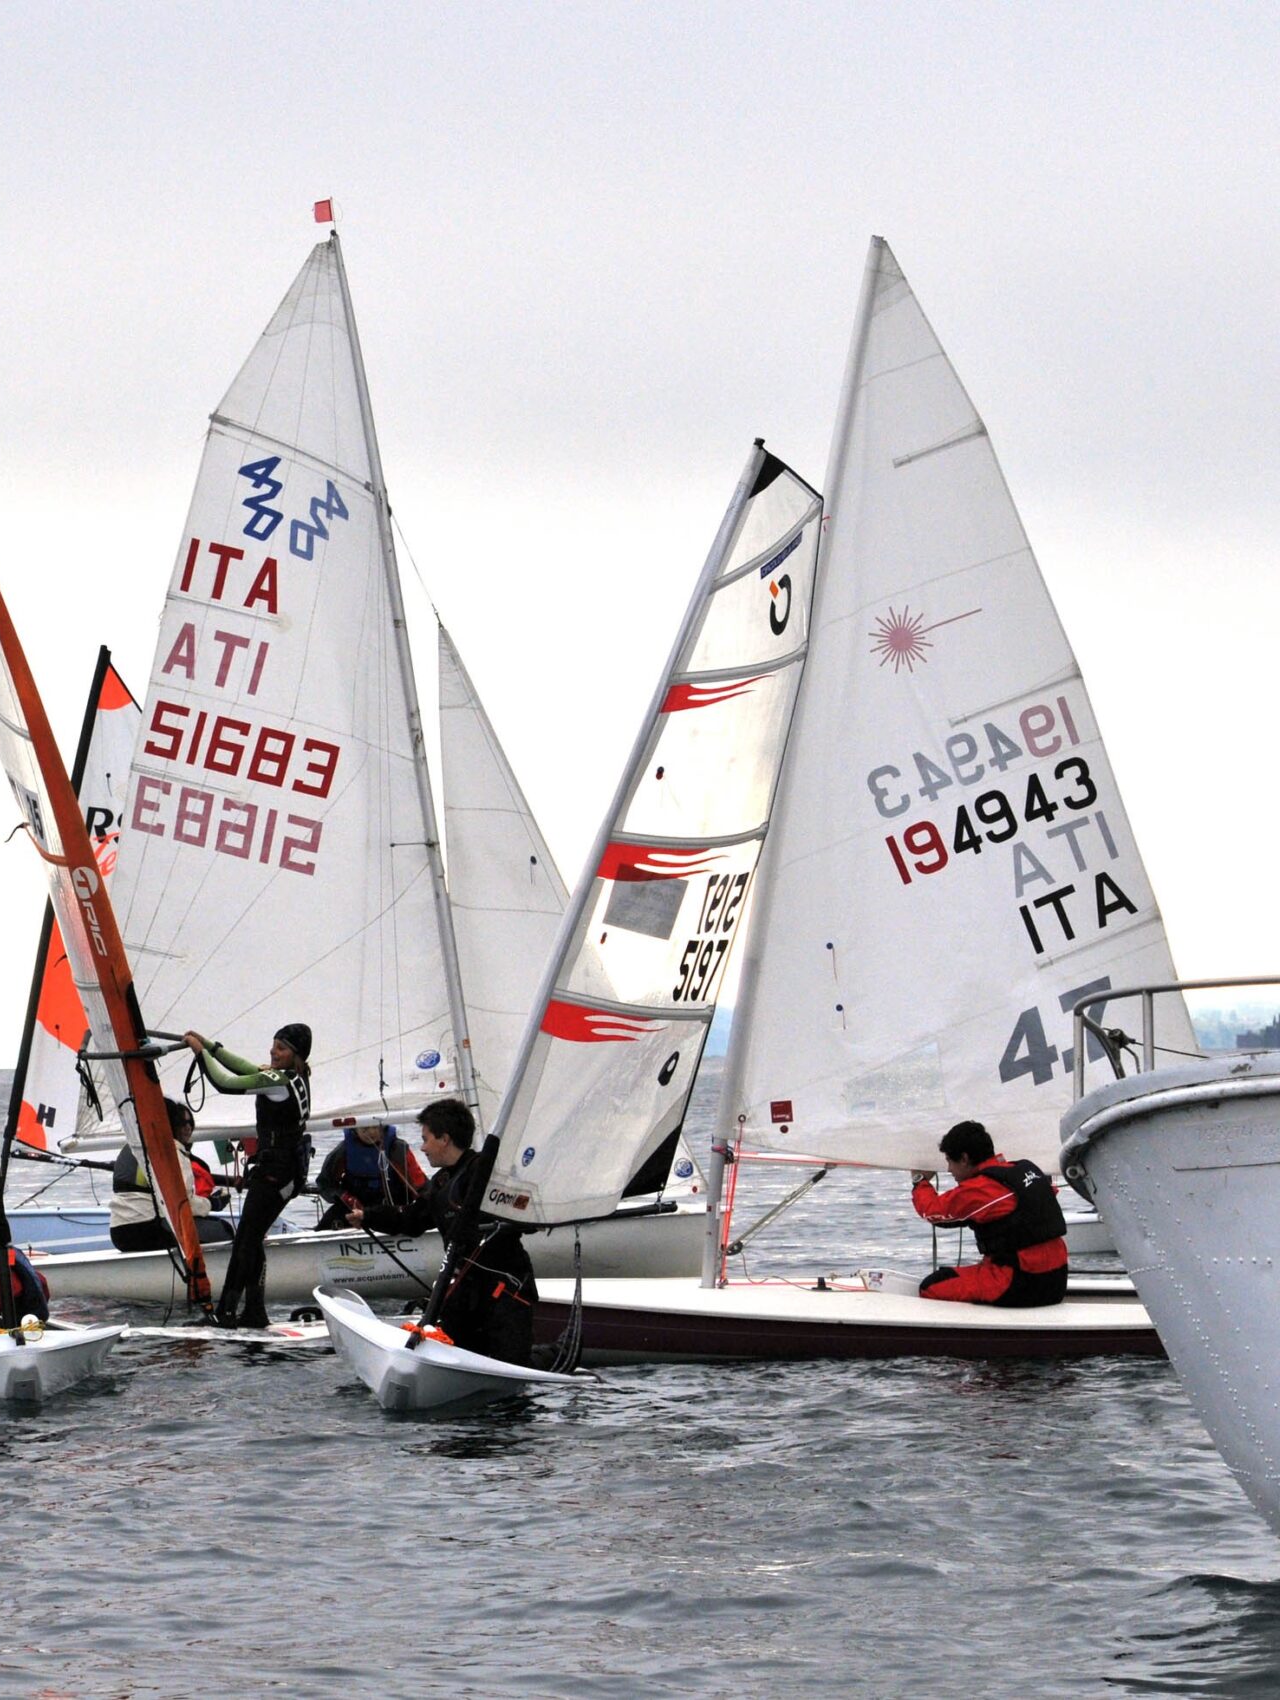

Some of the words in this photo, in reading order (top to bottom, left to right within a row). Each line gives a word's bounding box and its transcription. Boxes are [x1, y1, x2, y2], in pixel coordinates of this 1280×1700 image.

[238, 456, 284, 541] 420
[180, 537, 278, 614] ITA
[144, 700, 341, 799] 51683
[885, 757, 1097, 885] 194943
[1019, 871, 1138, 954] ITA
[673, 940, 729, 1002] 5197
